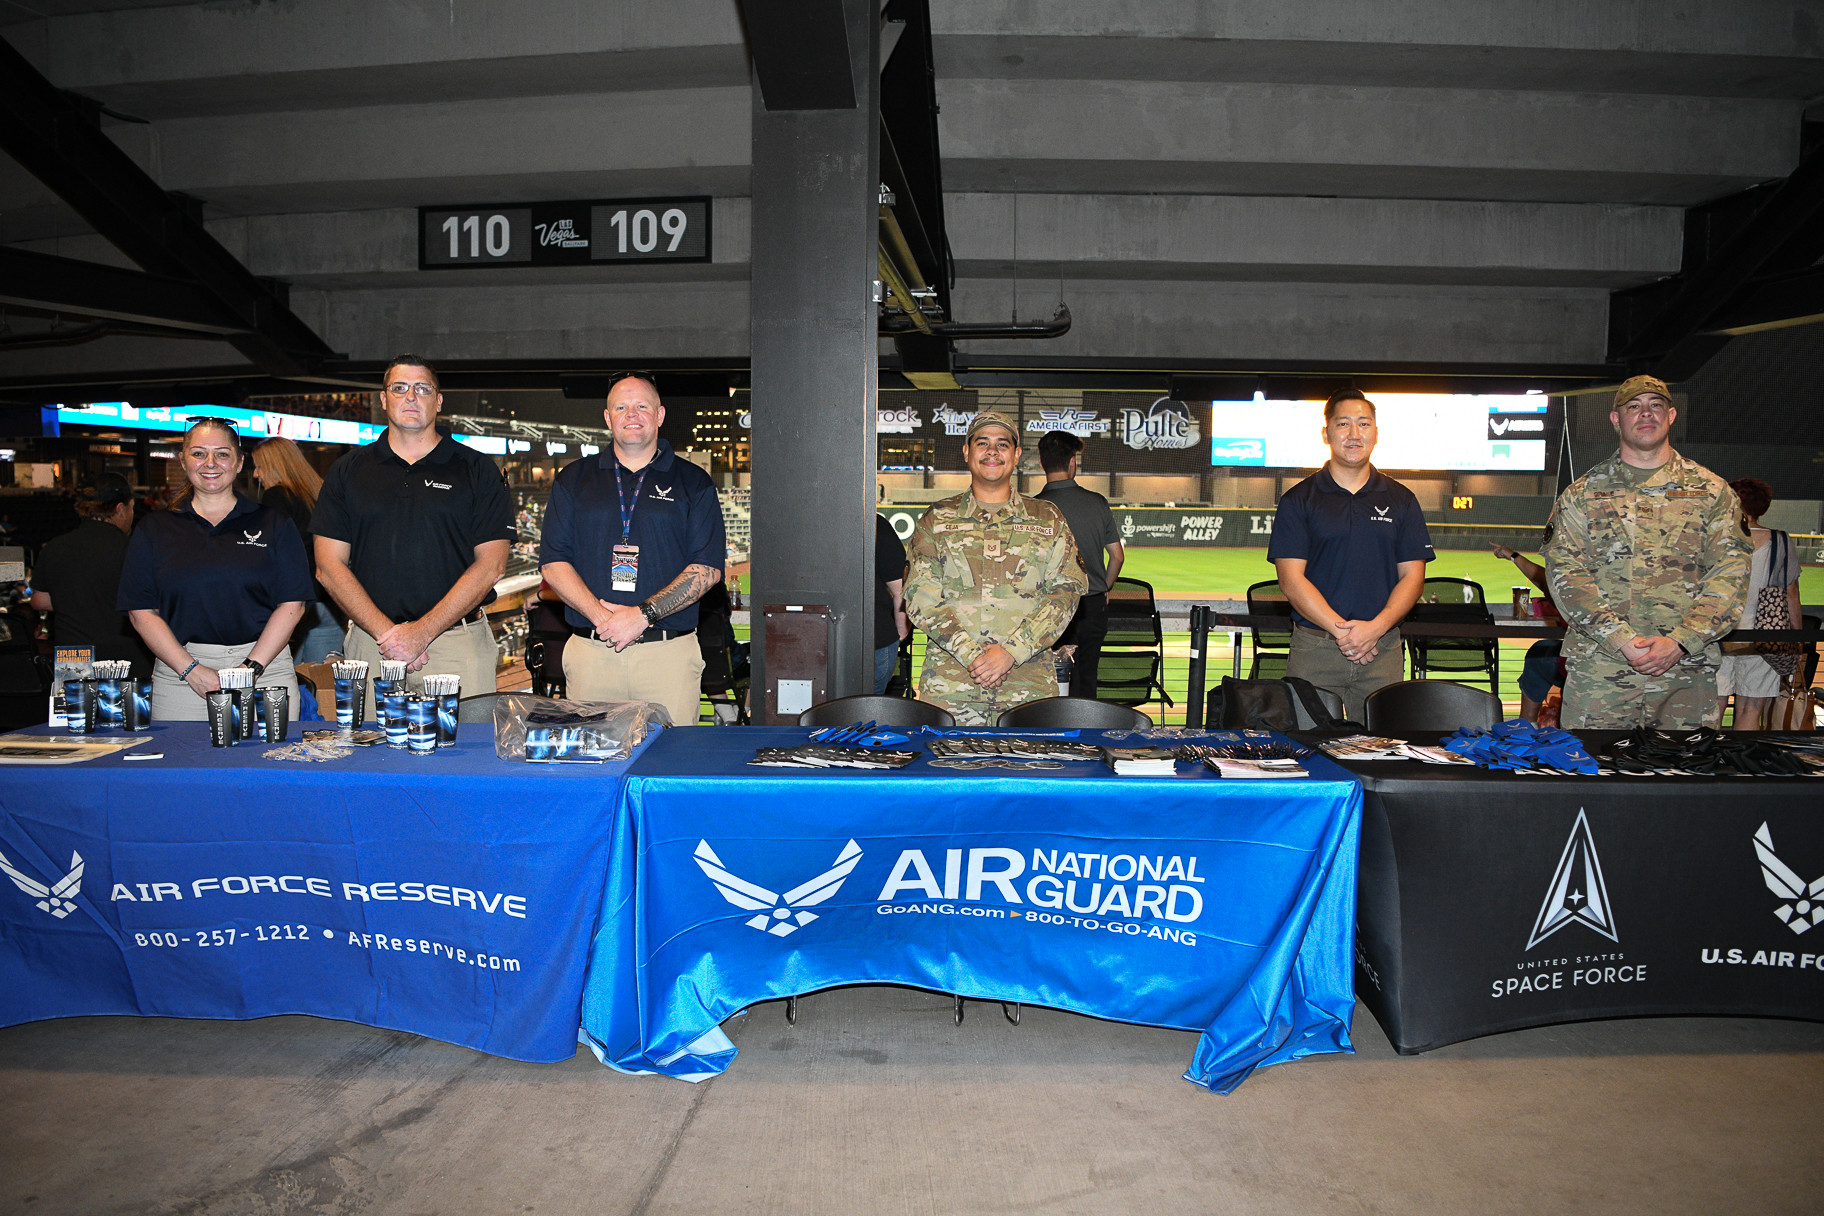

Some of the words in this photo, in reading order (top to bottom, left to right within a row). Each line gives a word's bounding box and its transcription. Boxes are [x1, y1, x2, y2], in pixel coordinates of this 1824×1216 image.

[442, 214, 510, 258] 110
[534, 221, 579, 247] Vegas
[611, 208, 687, 253] 109
[948, 424, 968, 433] Hea
[1028, 421, 1077, 431] AMERICA
[1078, 421, 1109, 431] FIRST
[1122, 409, 1190, 443] Pulte
[1036, 526, 1052, 535] FORCE
[1136, 523, 1176, 533] powershift
[1181, 516, 1223, 528] POWER
[1183, 528, 1219, 541] ALLEY
[1250, 515, 1275, 534] Li
[56, 649, 77, 658] EXPLORE
[78, 649, 91, 657] YOUR
[216, 713, 224, 745] RESERVE
[877, 847, 1024, 904] AIR
[1032, 848, 1205, 883] NATIONAL
[111, 883, 183, 902] AIR
[191, 876, 333, 898] FORCE
[342, 882, 526, 918] RESERVE
[1026, 875, 1203, 923] GUARD
[876, 904, 1005, 919] GoANG.com
[1025, 911, 1197, 947] 800-TO-GO-ANG
[134, 924, 310, 948] 800-257-1212
[348, 931, 521, 972] AFReserve.com
[1517, 958, 1568, 970] UNITED
[1576, 953, 1624, 964] STATES
[1701, 948, 1748, 965] U.S.
[1751, 950, 1795, 968] AIR
[1355, 946, 1381, 992] ORCE
[1491, 972, 1564, 998] SPACE
[1573, 965, 1647, 987] FORCE
